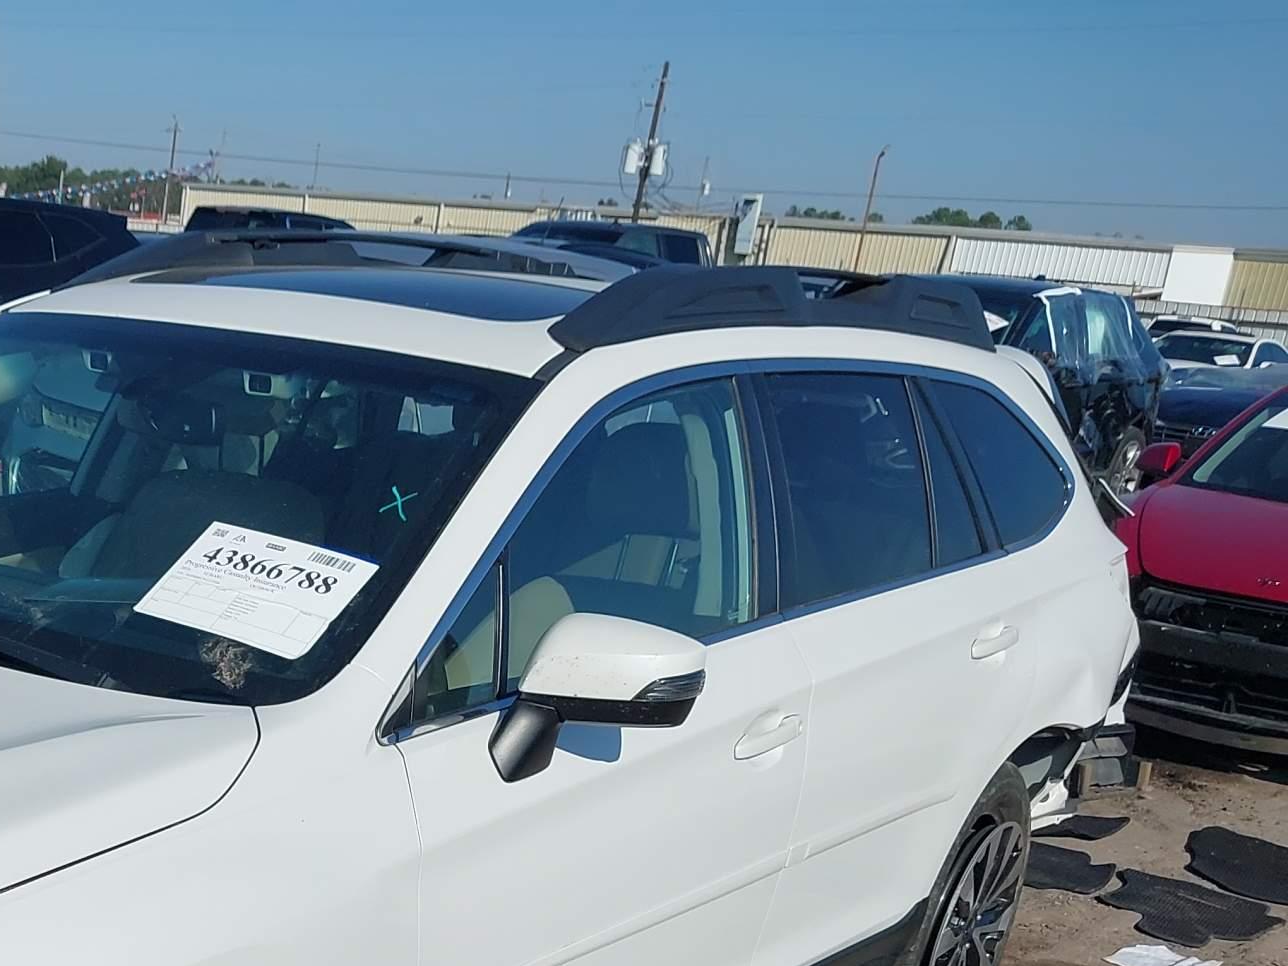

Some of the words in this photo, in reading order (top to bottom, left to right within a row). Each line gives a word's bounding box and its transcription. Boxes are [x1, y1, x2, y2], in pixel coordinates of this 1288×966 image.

[185, 559, 223, 573] Progressive
[253, 576, 287, 590] Insurance
[202, 546, 339, 595] 43866788
